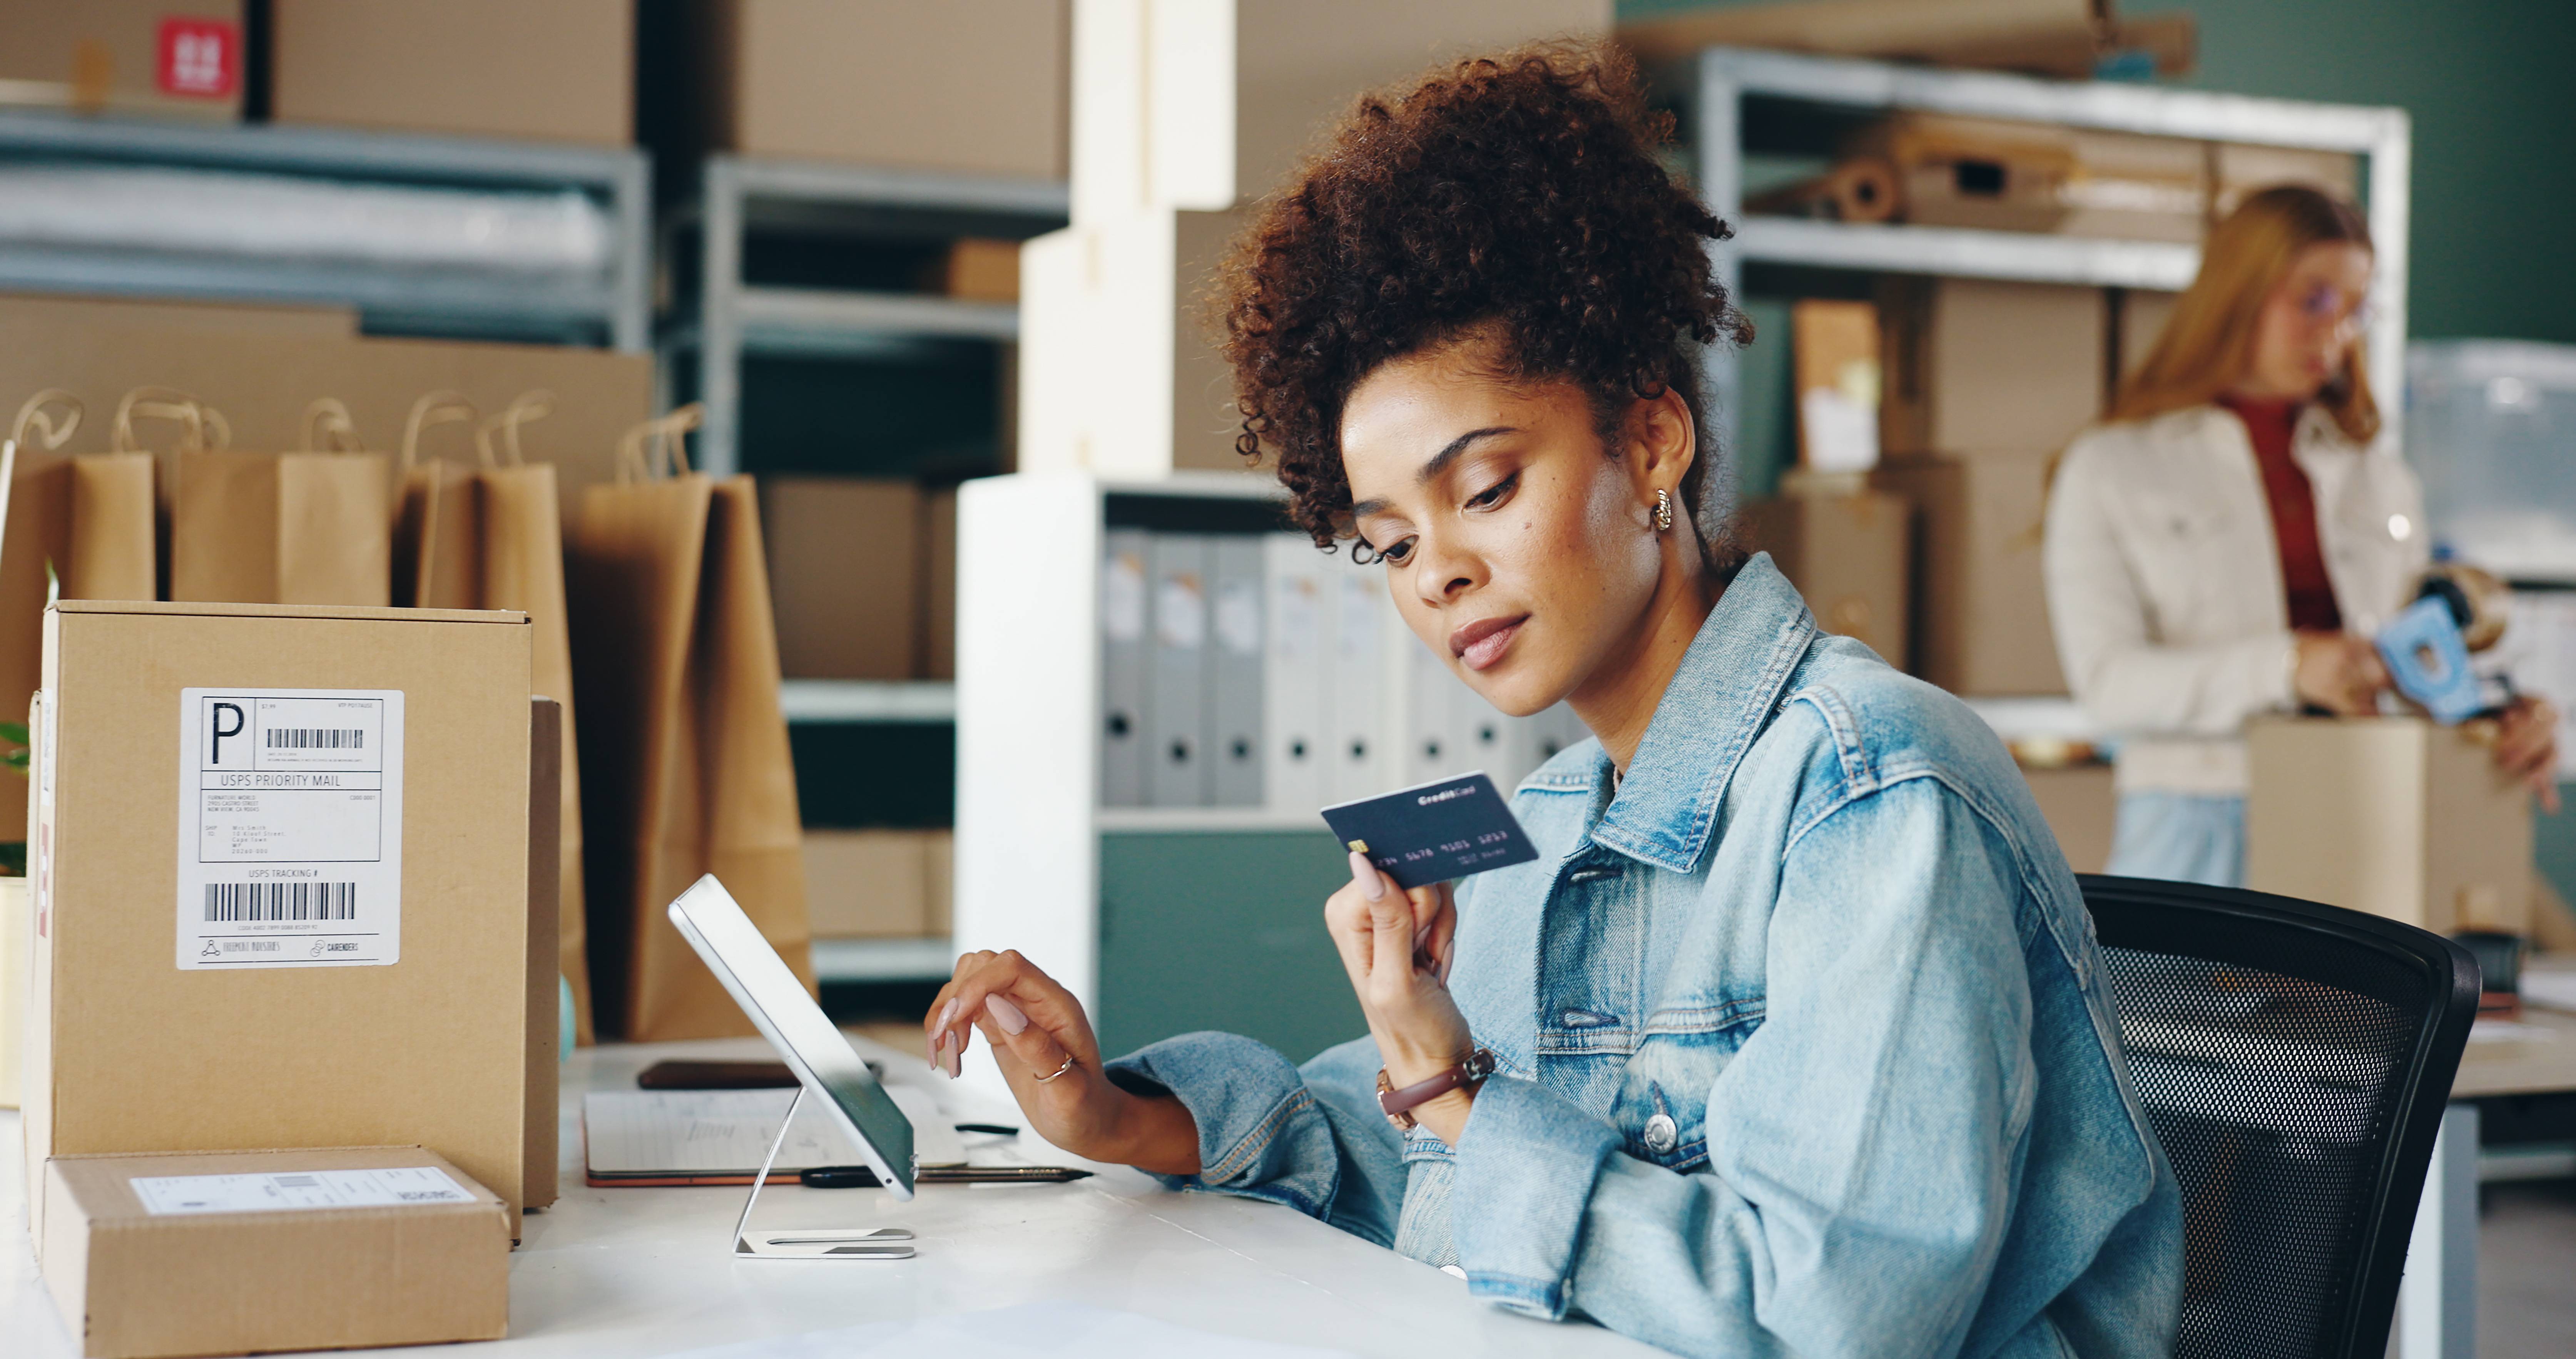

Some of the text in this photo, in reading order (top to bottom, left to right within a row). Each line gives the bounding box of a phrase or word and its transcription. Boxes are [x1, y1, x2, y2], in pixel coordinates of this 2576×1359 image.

[212, 703, 244, 764] P
[221, 775, 341, 786] USPS PRIORITY MAIL
